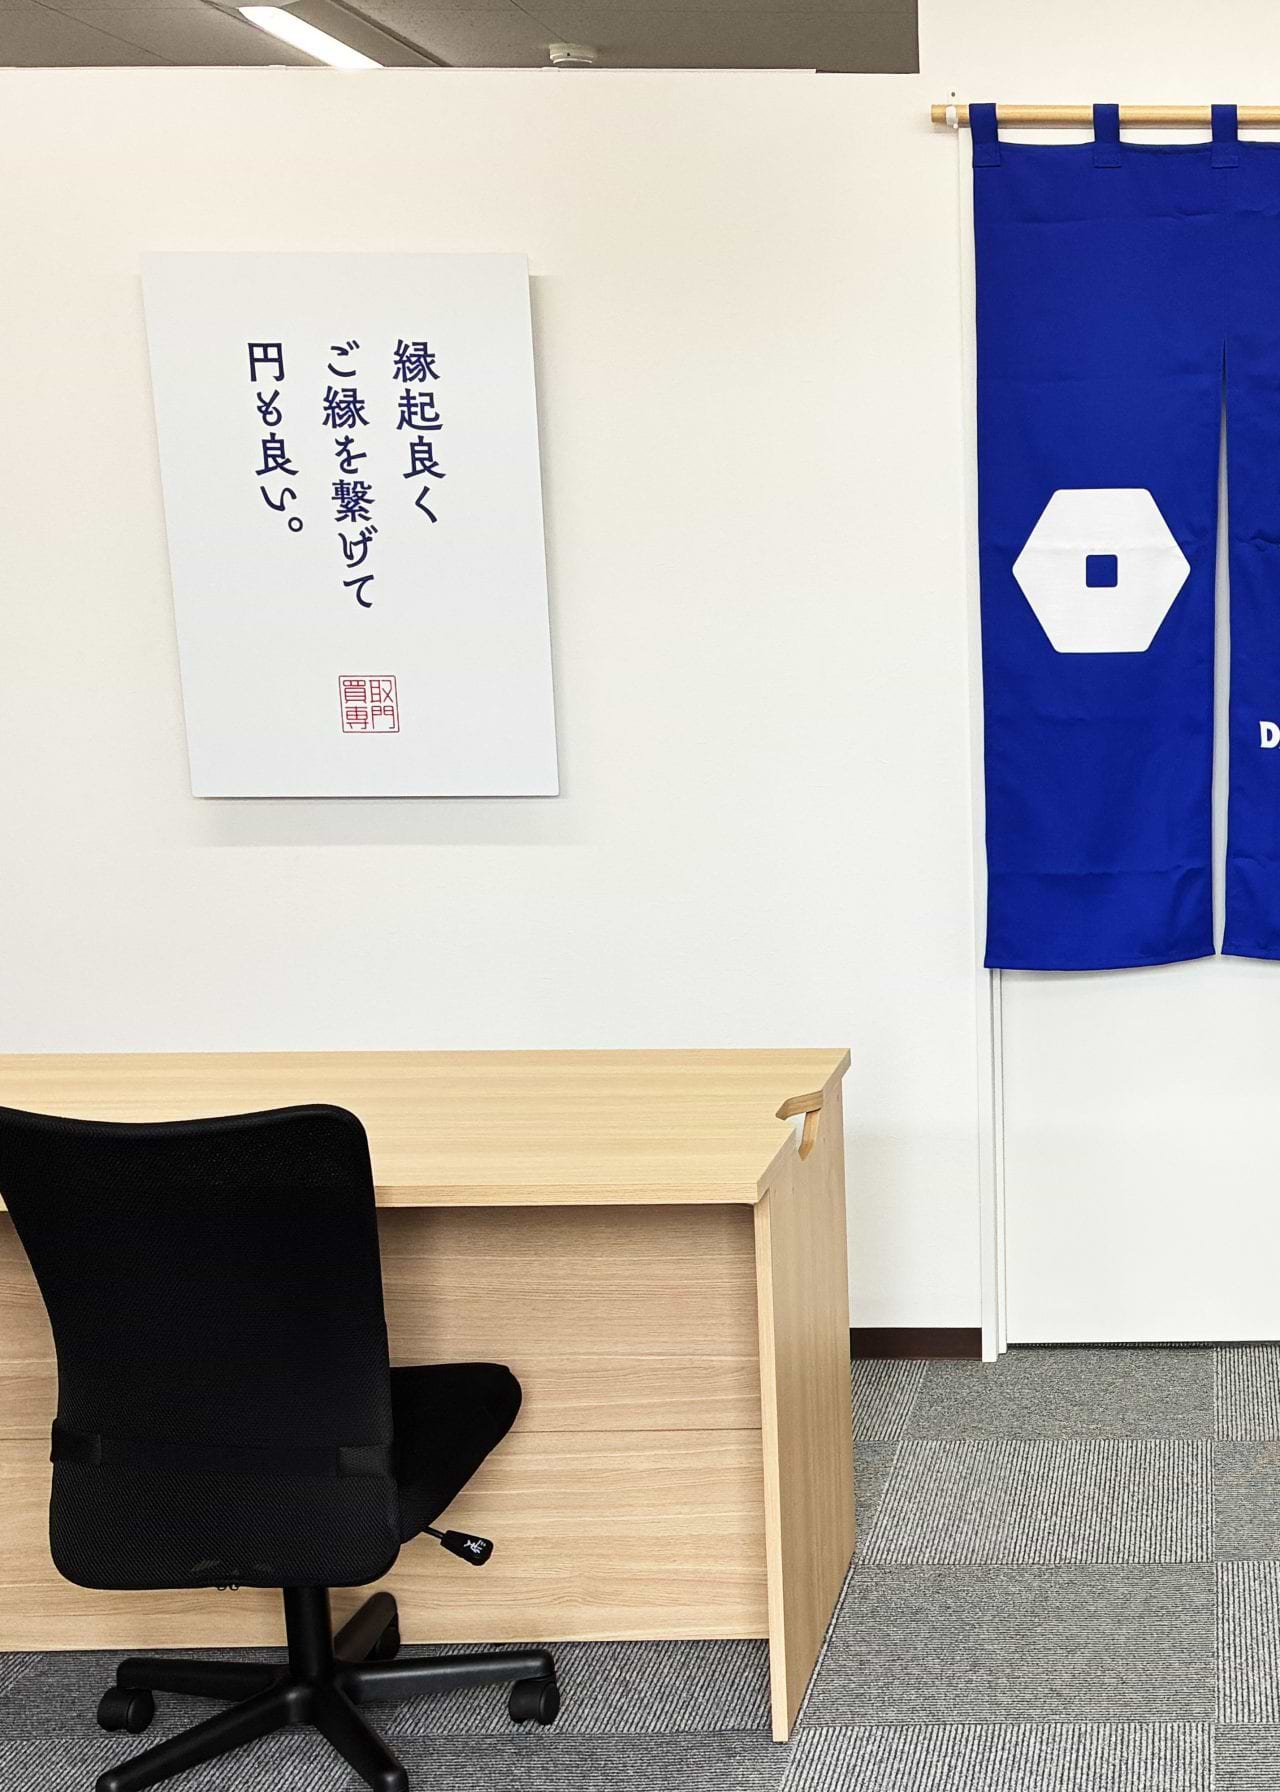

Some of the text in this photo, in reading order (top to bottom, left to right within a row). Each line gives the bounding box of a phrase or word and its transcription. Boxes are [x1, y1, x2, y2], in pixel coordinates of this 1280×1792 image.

[248, 342, 303, 533] 円も良い。
[323, 340, 378, 608] ご縁を繋げて
[393, 339, 445, 523] 縁起良く
[343, 679, 393, 703] 買取
